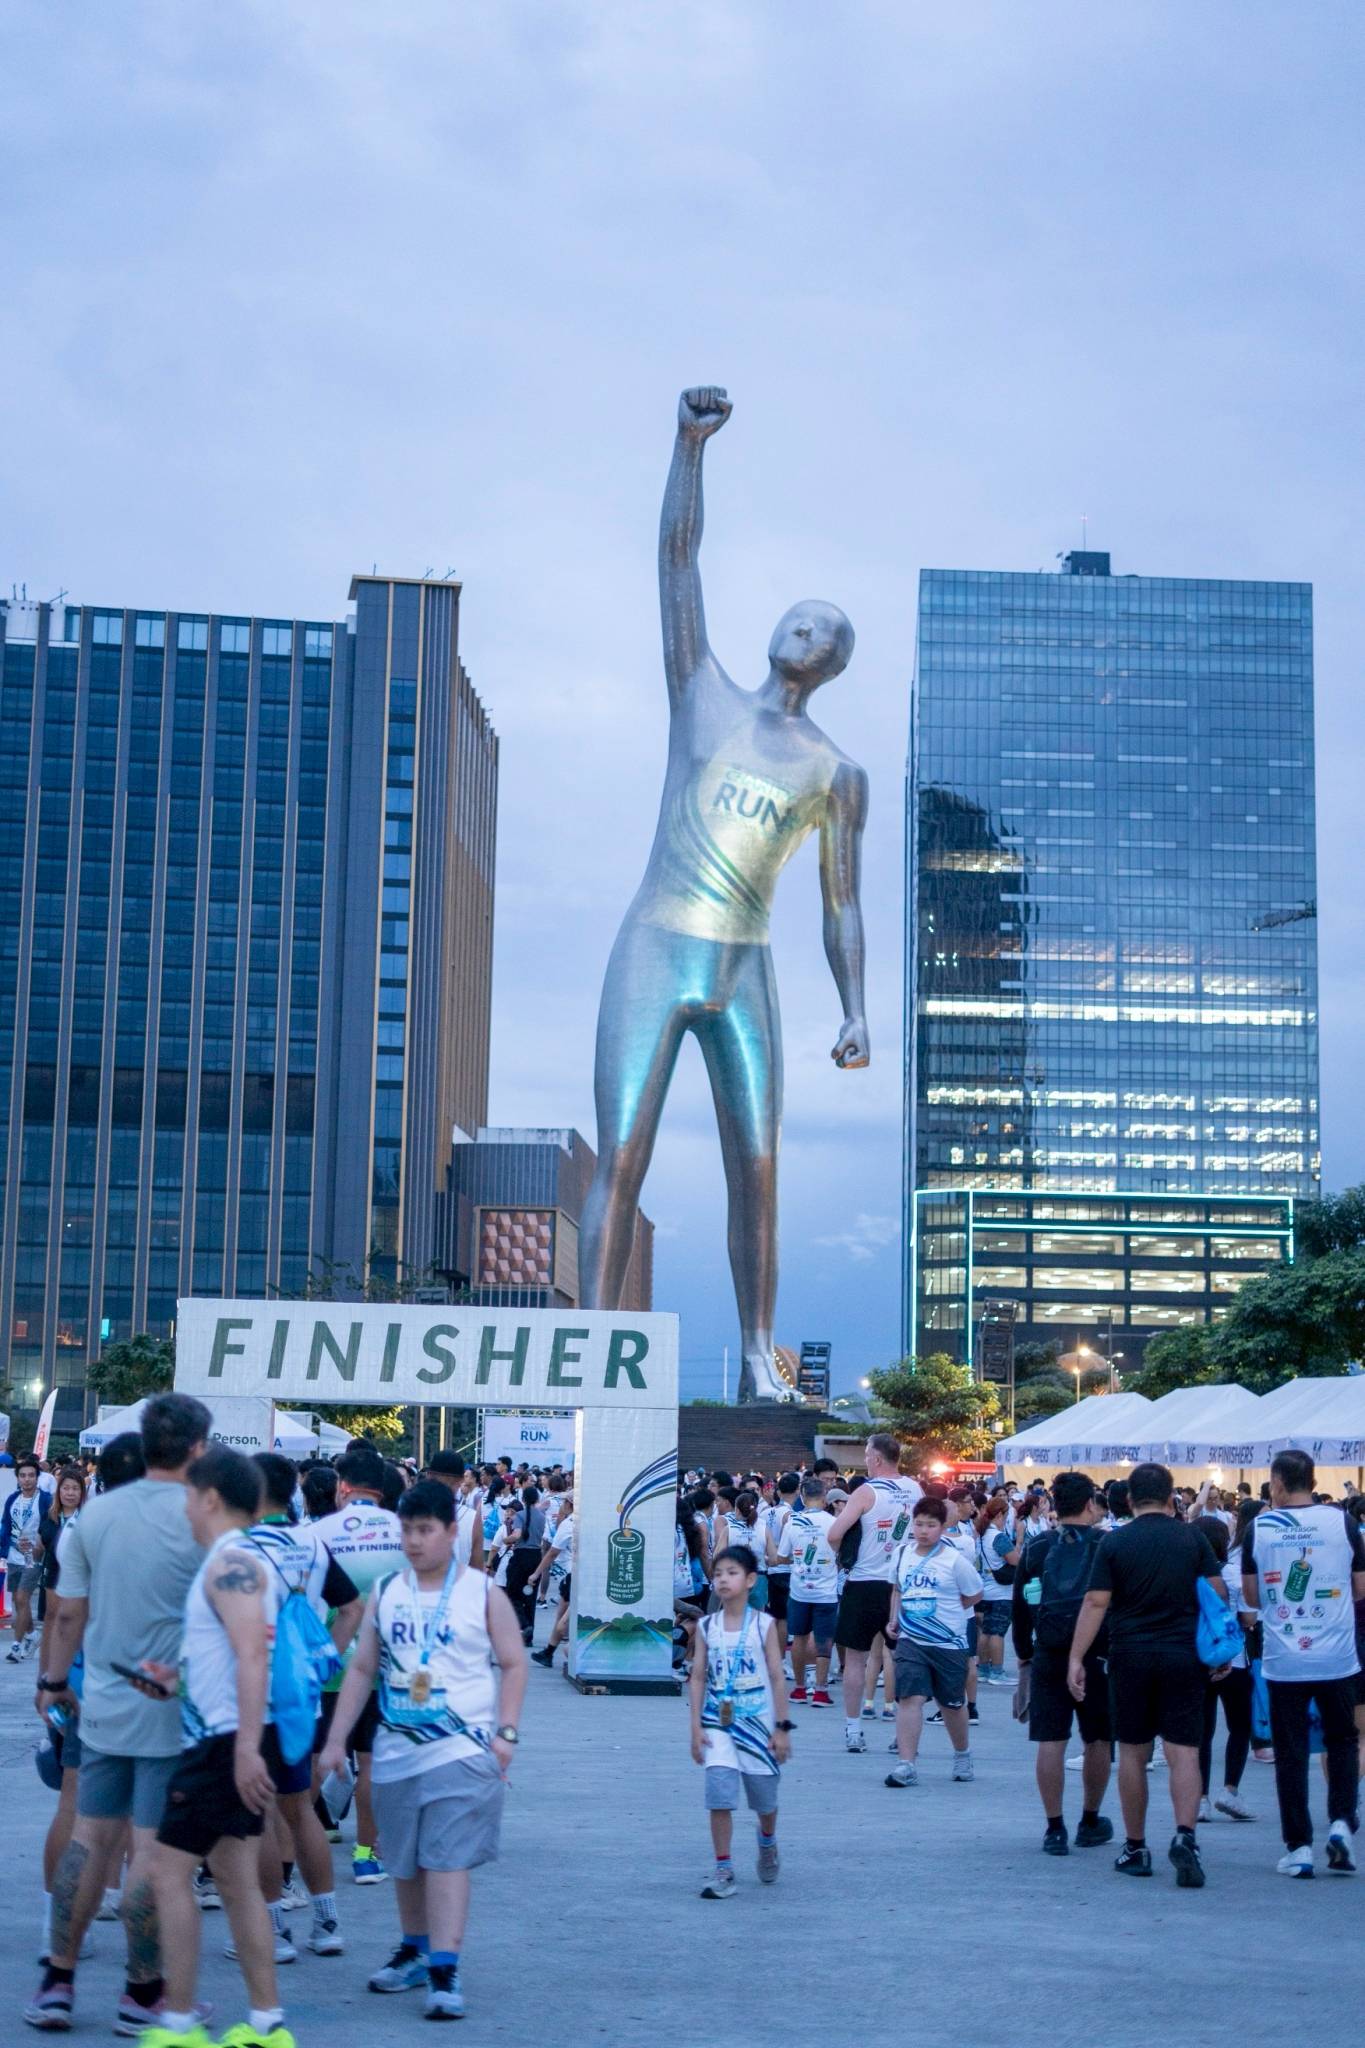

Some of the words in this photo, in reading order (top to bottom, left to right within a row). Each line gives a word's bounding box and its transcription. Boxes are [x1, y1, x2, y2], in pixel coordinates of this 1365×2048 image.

[713, 781, 793, 834] RUN
[208, 1317, 650, 1390] FINISHER
[213, 1433, 261, 1446] Person,
[520, 1430, 549, 1441] RUN
[1185, 1446, 1196, 1463] XS
[1218, 1445, 1254, 1464] FINISHERS
[1267, 1444, 1273, 1463] S
[1312, 1441, 1324, 1460] M
[358, 1543, 403, 1552] FINISHE
